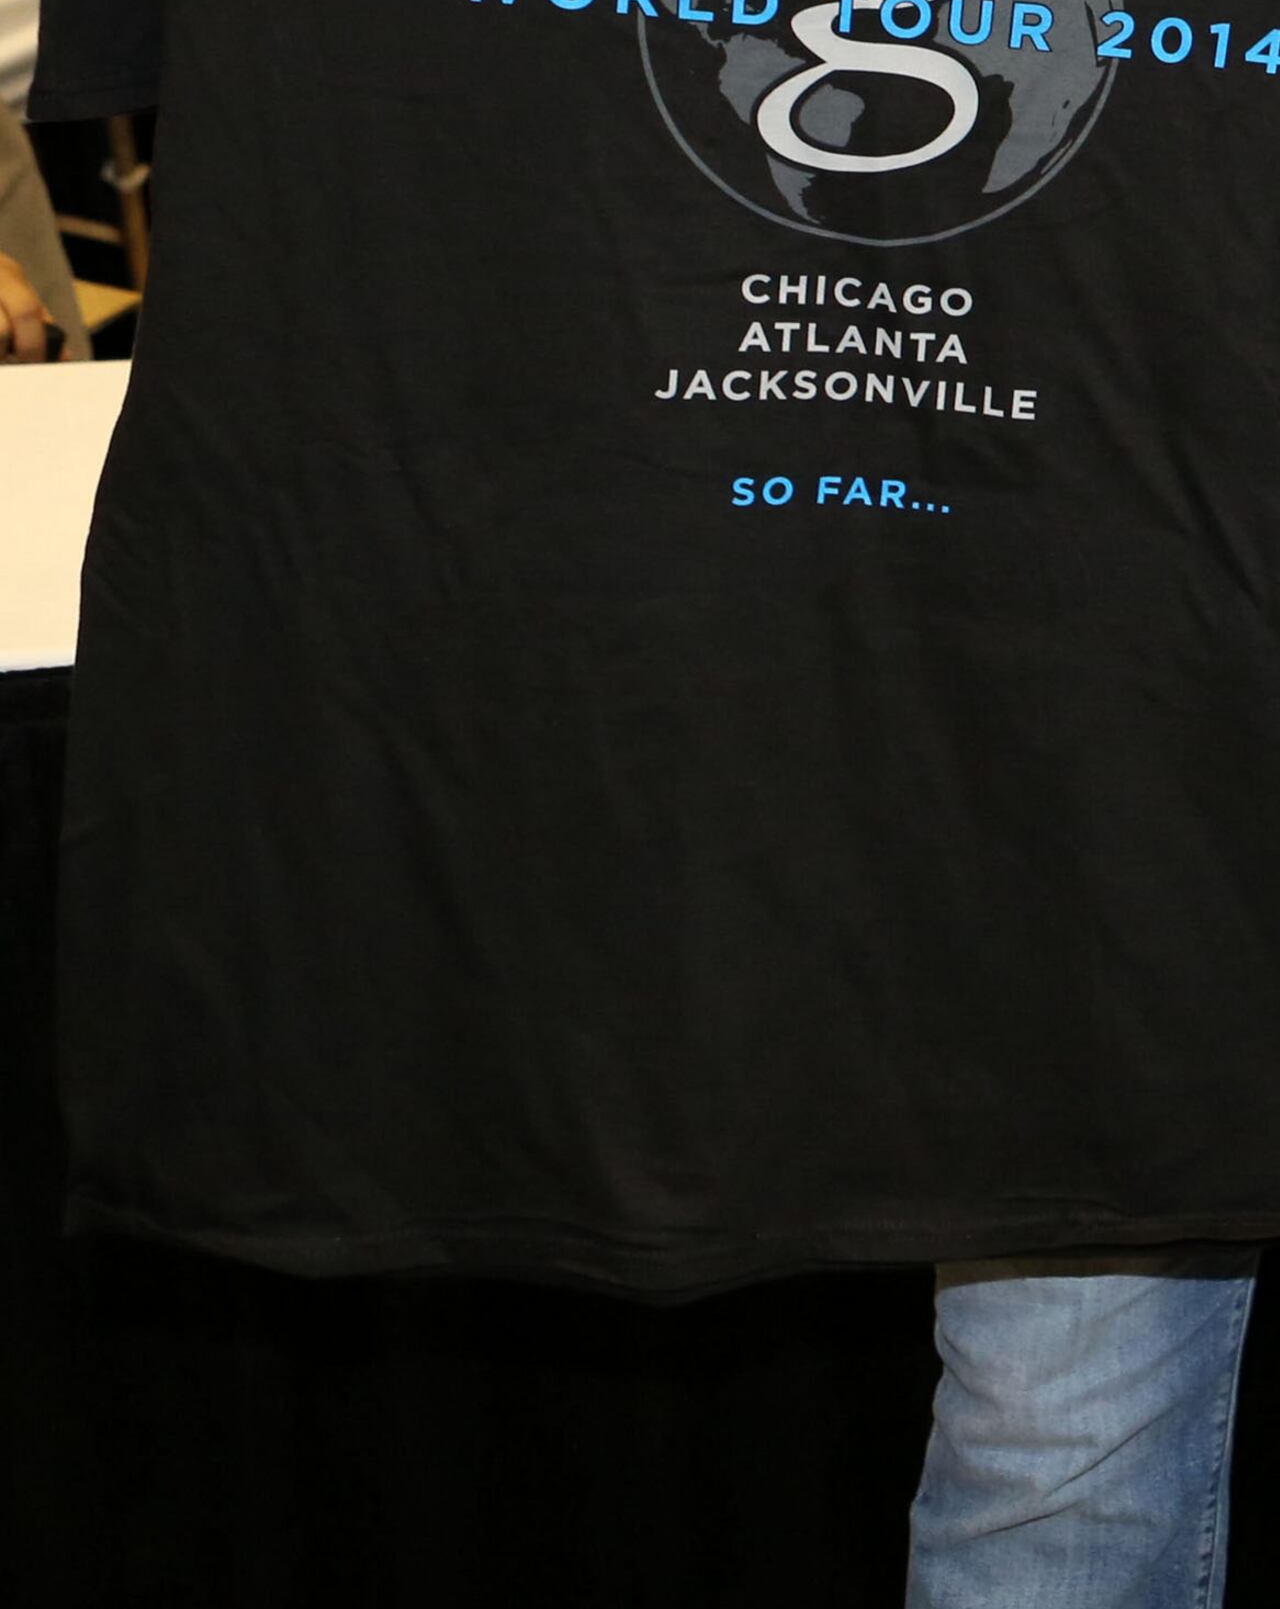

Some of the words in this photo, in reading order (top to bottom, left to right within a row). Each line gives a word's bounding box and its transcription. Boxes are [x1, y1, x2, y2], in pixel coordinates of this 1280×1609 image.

[741, 274, 974, 317] CHICAGO
[738, 322, 968, 365] ATLANTA
[654, 369, 1038, 421] JACKSONVILLE
[731, 476, 794, 506] SO
[816, 476, 951, 514] FAR...
